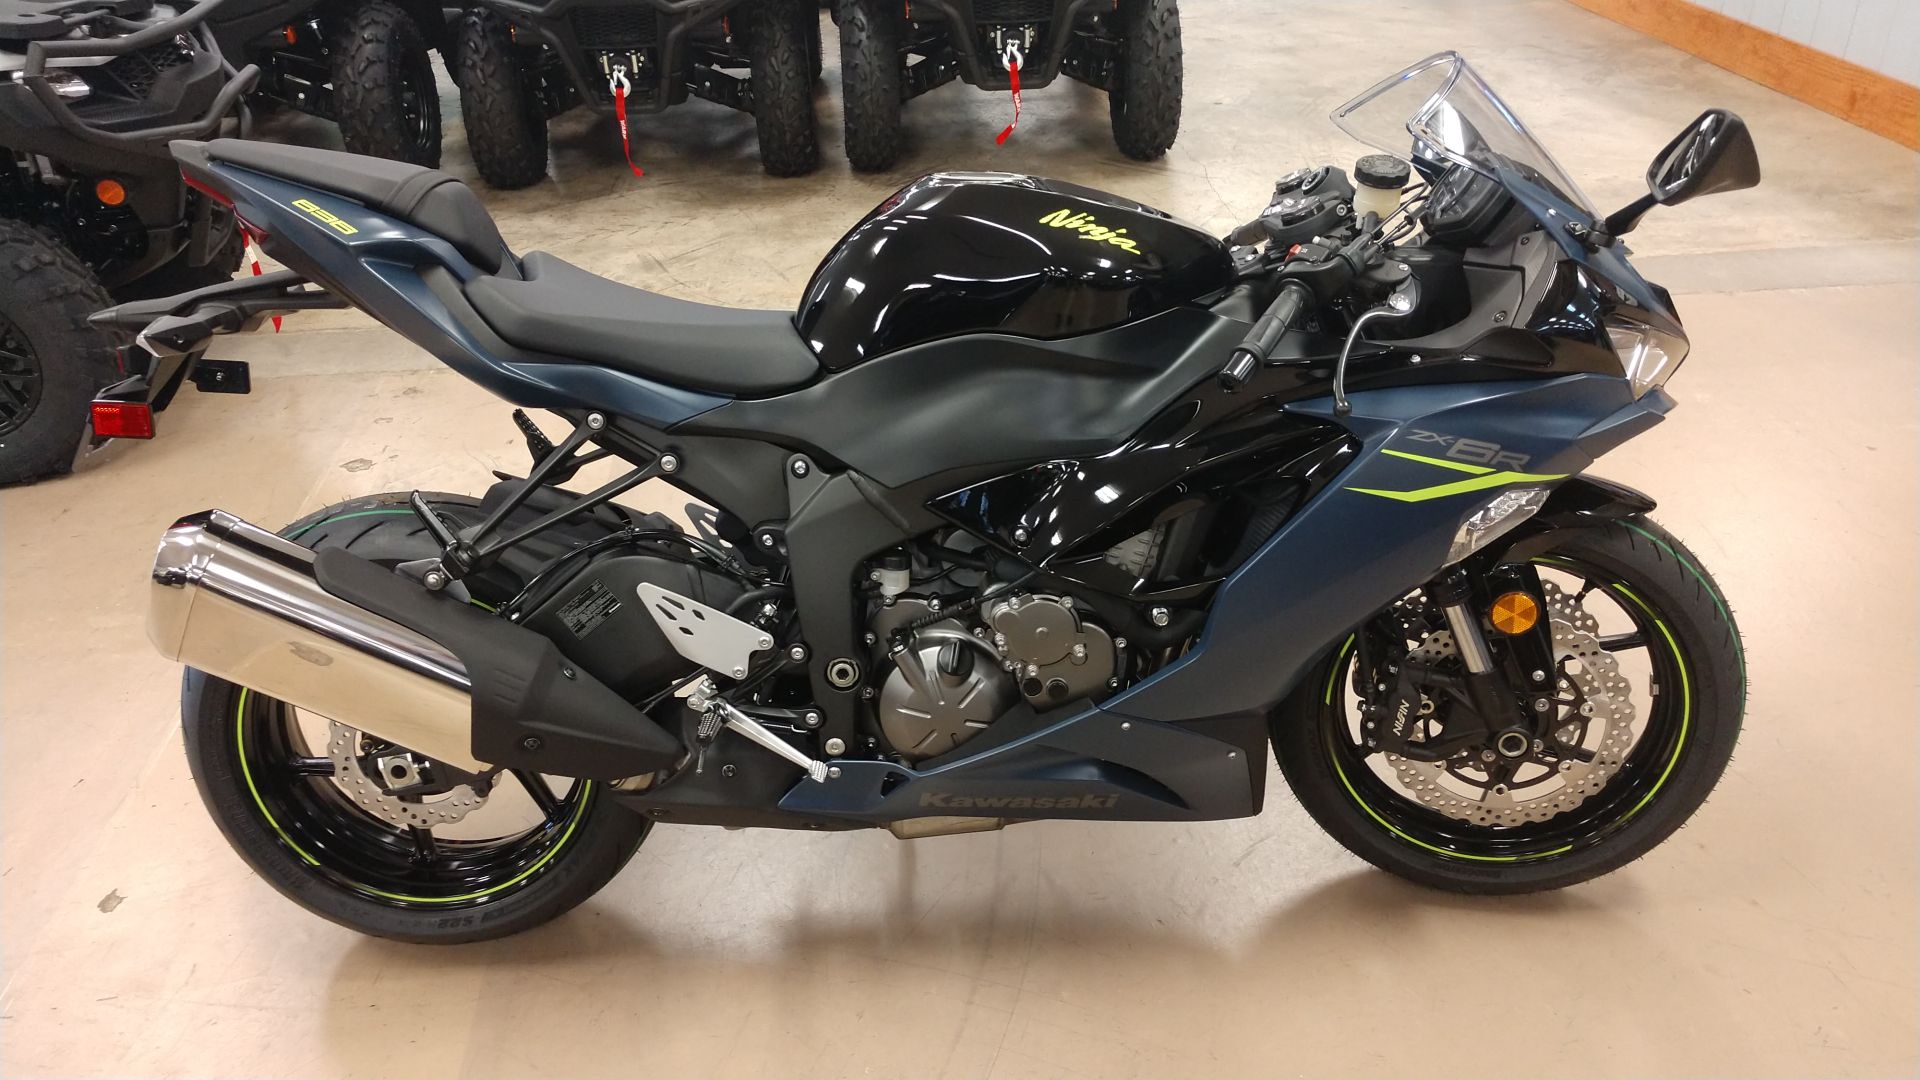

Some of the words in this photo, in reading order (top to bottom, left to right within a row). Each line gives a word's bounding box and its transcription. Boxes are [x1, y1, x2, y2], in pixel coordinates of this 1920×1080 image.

[1039, 208, 1141, 255] Ninja
[1405, 429, 1531, 472] ZX-6R
[1392, 699, 1410, 737] NISSIN
[918, 792, 1120, 809] Kawasaki
